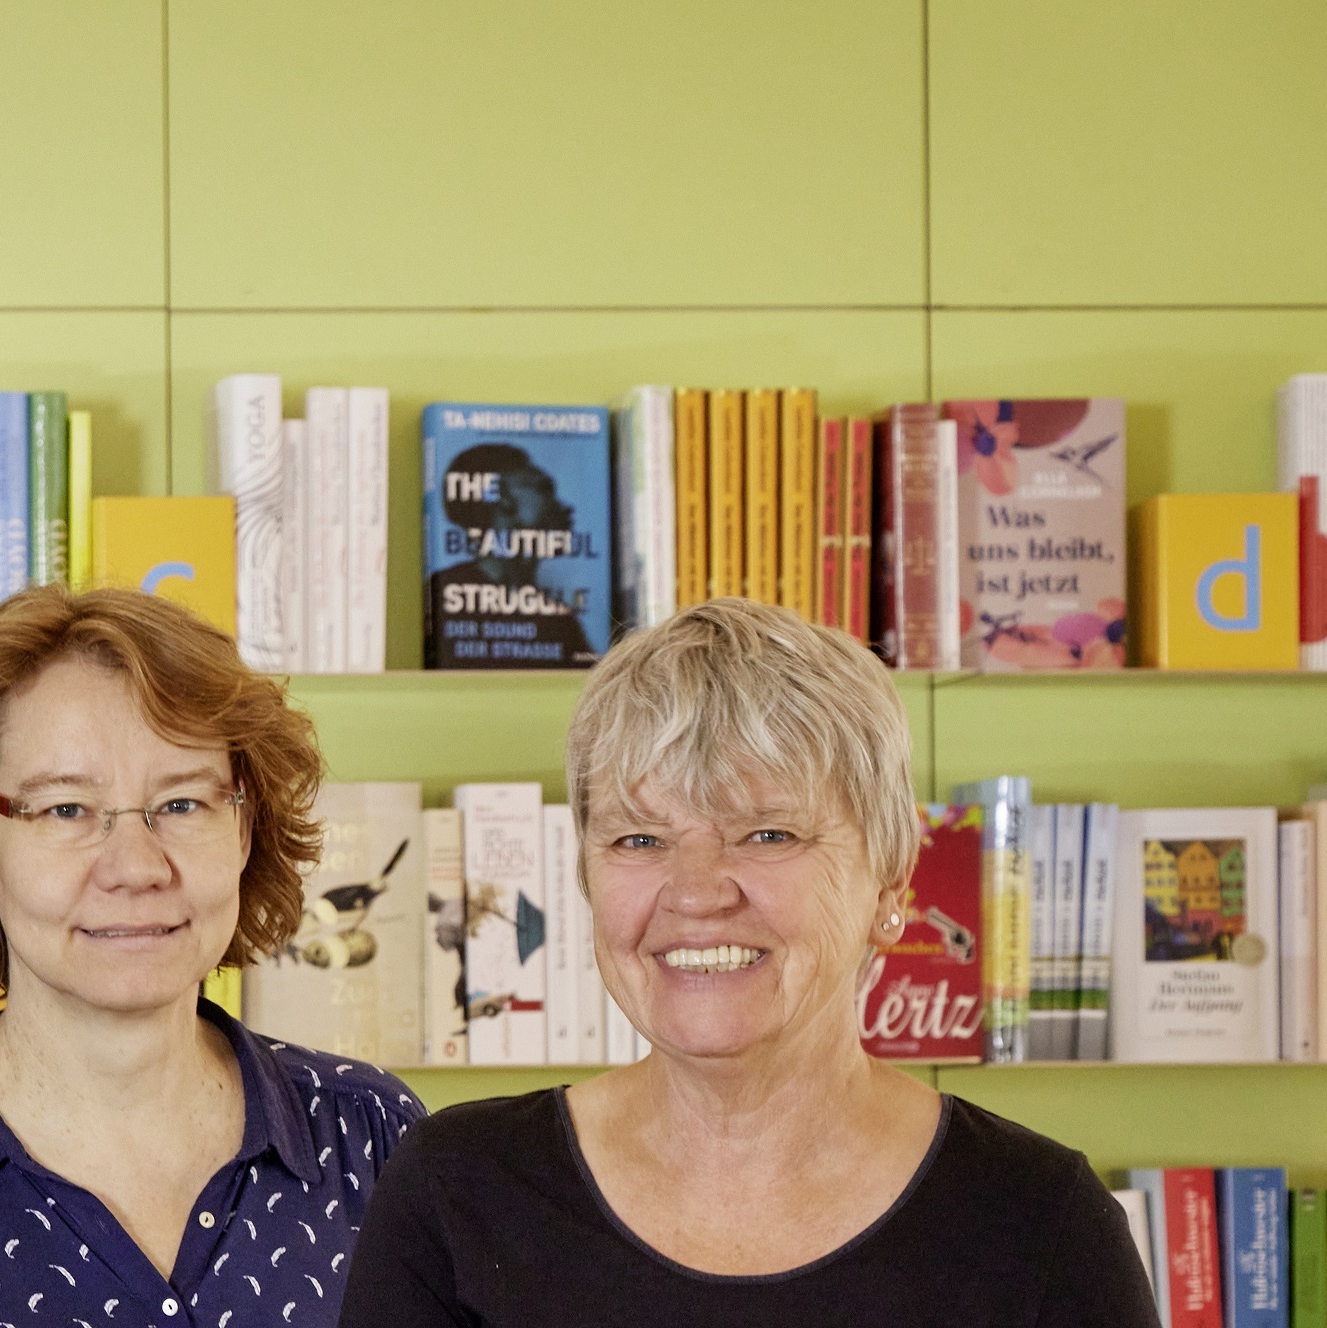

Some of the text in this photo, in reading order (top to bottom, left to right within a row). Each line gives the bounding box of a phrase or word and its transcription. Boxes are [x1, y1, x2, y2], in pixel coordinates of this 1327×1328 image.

[246, 394, 266, 463] YOGA
[443, 410, 601, 434] TA-NEHISI COATES
[446, 472, 501, 501] THE
[987, 505, 1046, 529] Was
[968, 537, 1115, 564] uns bleibt,
[975, 569, 1081, 600] ist jetzt
[1195, 524, 1261, 632] d
